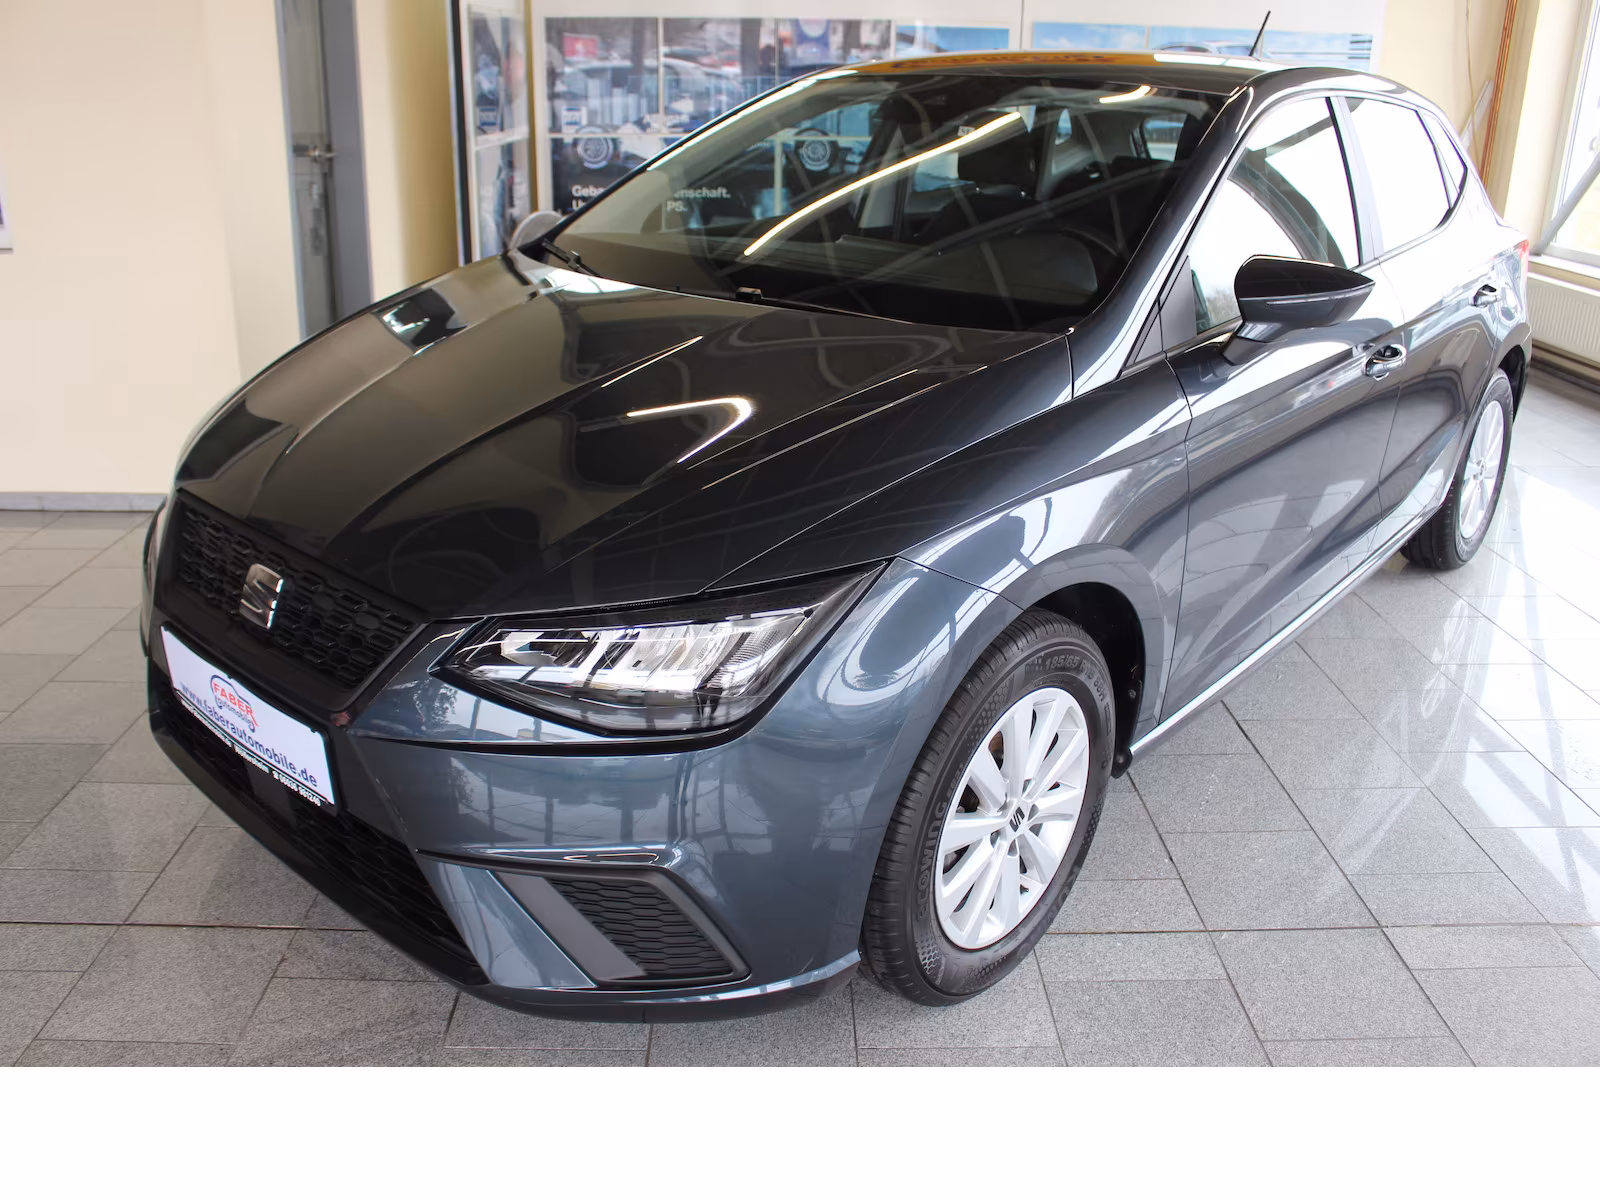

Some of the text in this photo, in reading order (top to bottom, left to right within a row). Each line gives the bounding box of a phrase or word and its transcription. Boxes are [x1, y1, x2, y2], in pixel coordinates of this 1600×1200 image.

[666, 201, 688, 212] PS.
[1045, 655, 1080, 671] 185/65
[213, 682, 254, 718] FABER
[180, 682, 318, 787] www.faberautomobile.de
[916, 801, 948, 922] ECOWING
